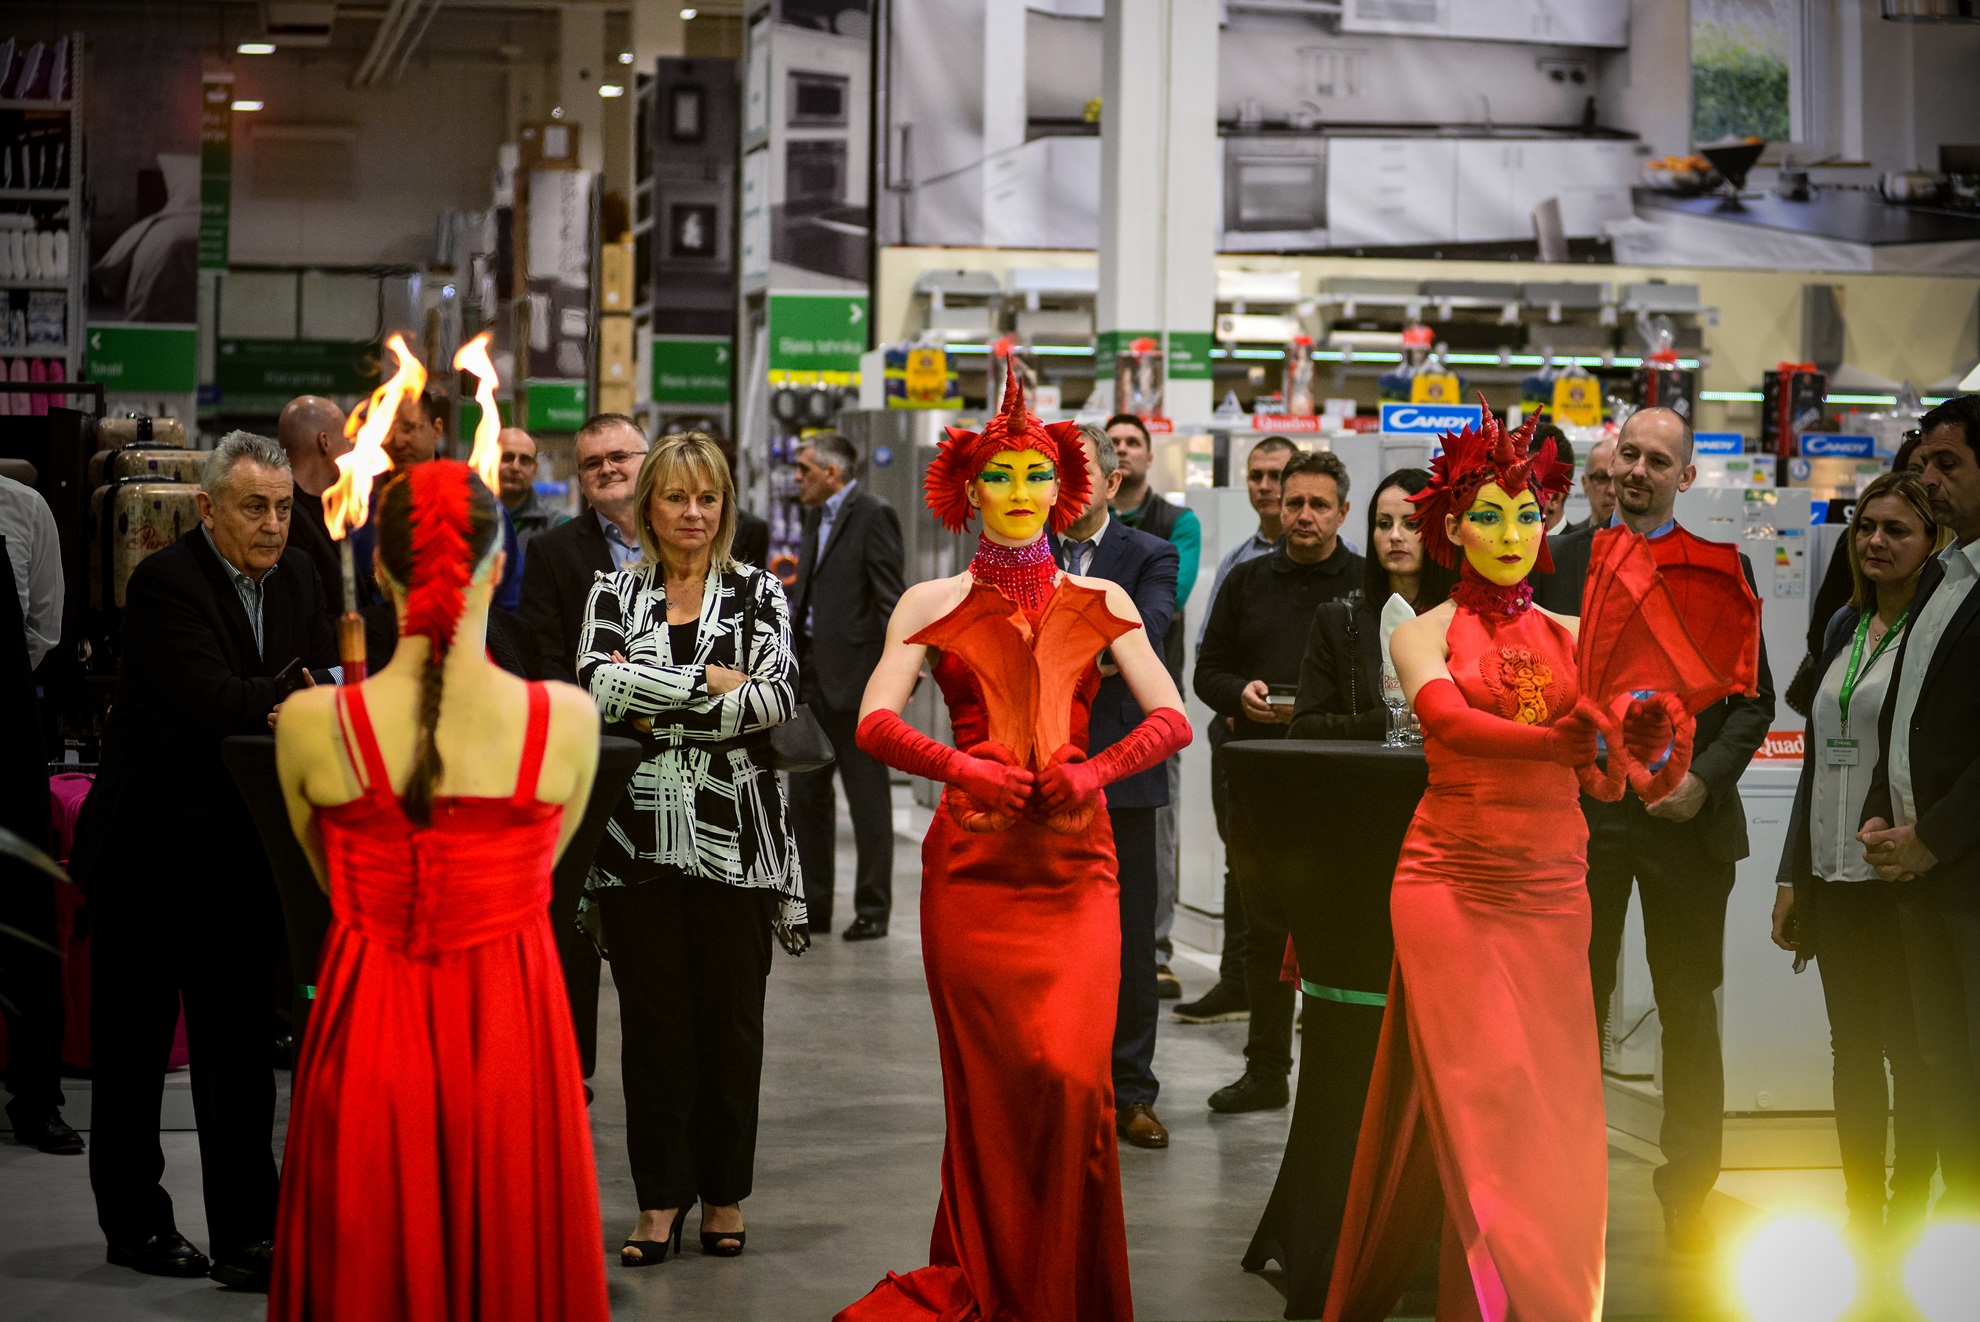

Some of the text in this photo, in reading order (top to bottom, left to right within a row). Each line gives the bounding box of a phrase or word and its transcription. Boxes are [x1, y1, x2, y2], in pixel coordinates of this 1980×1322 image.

[1258, 415, 1317, 430] Quadro
[1389, 408, 1474, 429] CANDY
[1695, 440, 1736, 452] ANDY
[1806, 437, 1868, 453] CANDY
[1757, 734, 1805, 757] Quad
